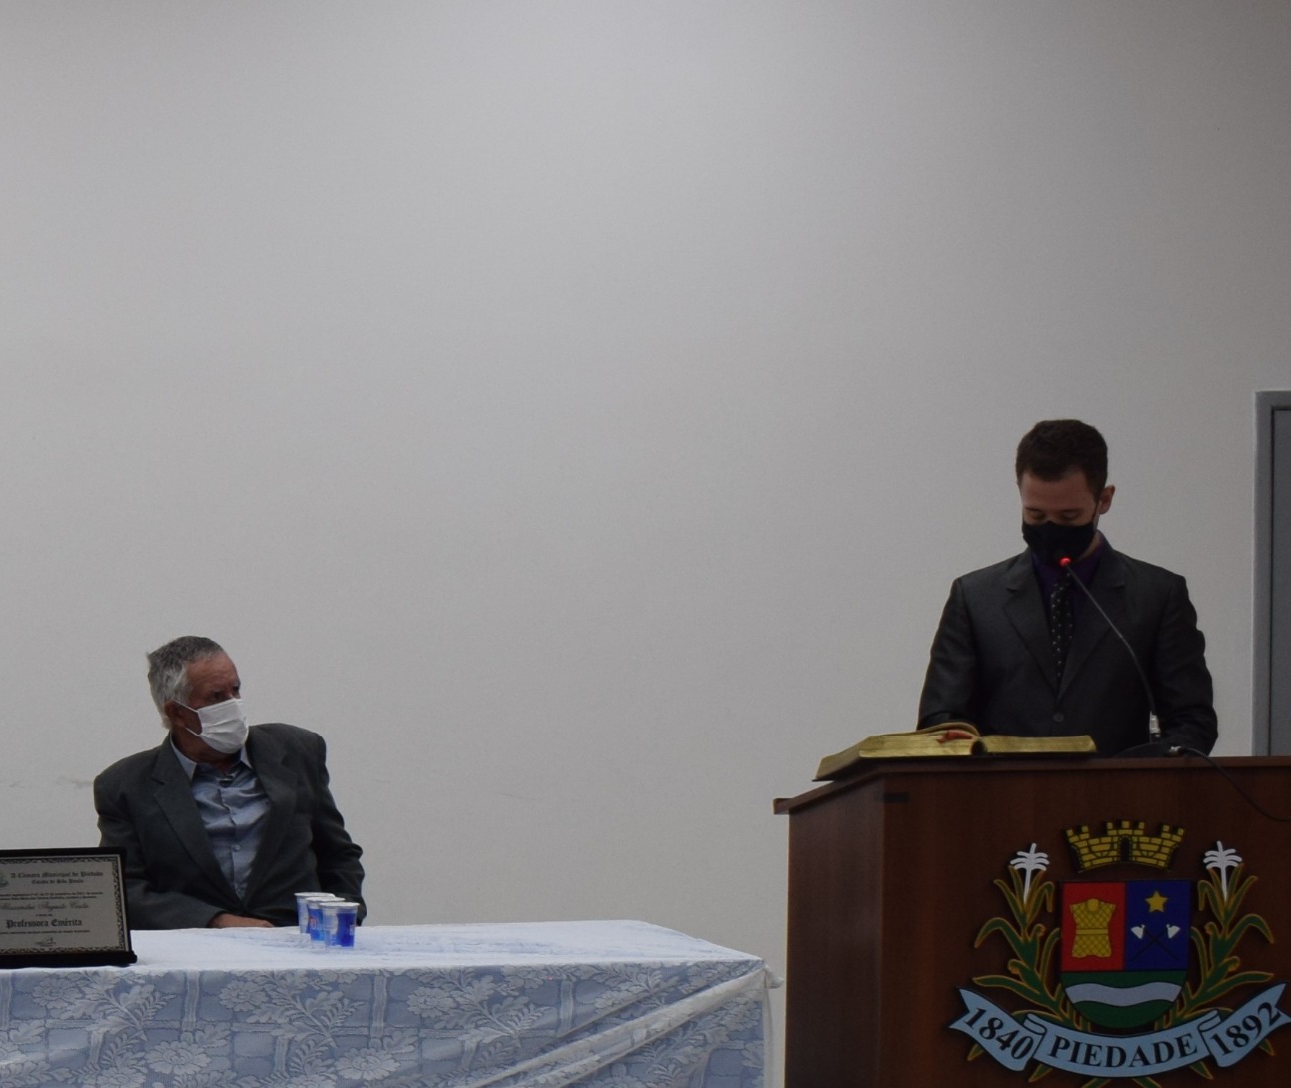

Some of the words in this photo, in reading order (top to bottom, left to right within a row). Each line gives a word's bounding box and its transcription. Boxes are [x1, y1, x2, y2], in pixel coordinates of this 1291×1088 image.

[6, 918, 49, 929] Professora
[964, 1008, 1034, 1060] 1840
[1048, 1032, 1198, 1068] PIEDADE
[1211, 1002, 1281, 1056] 1892
